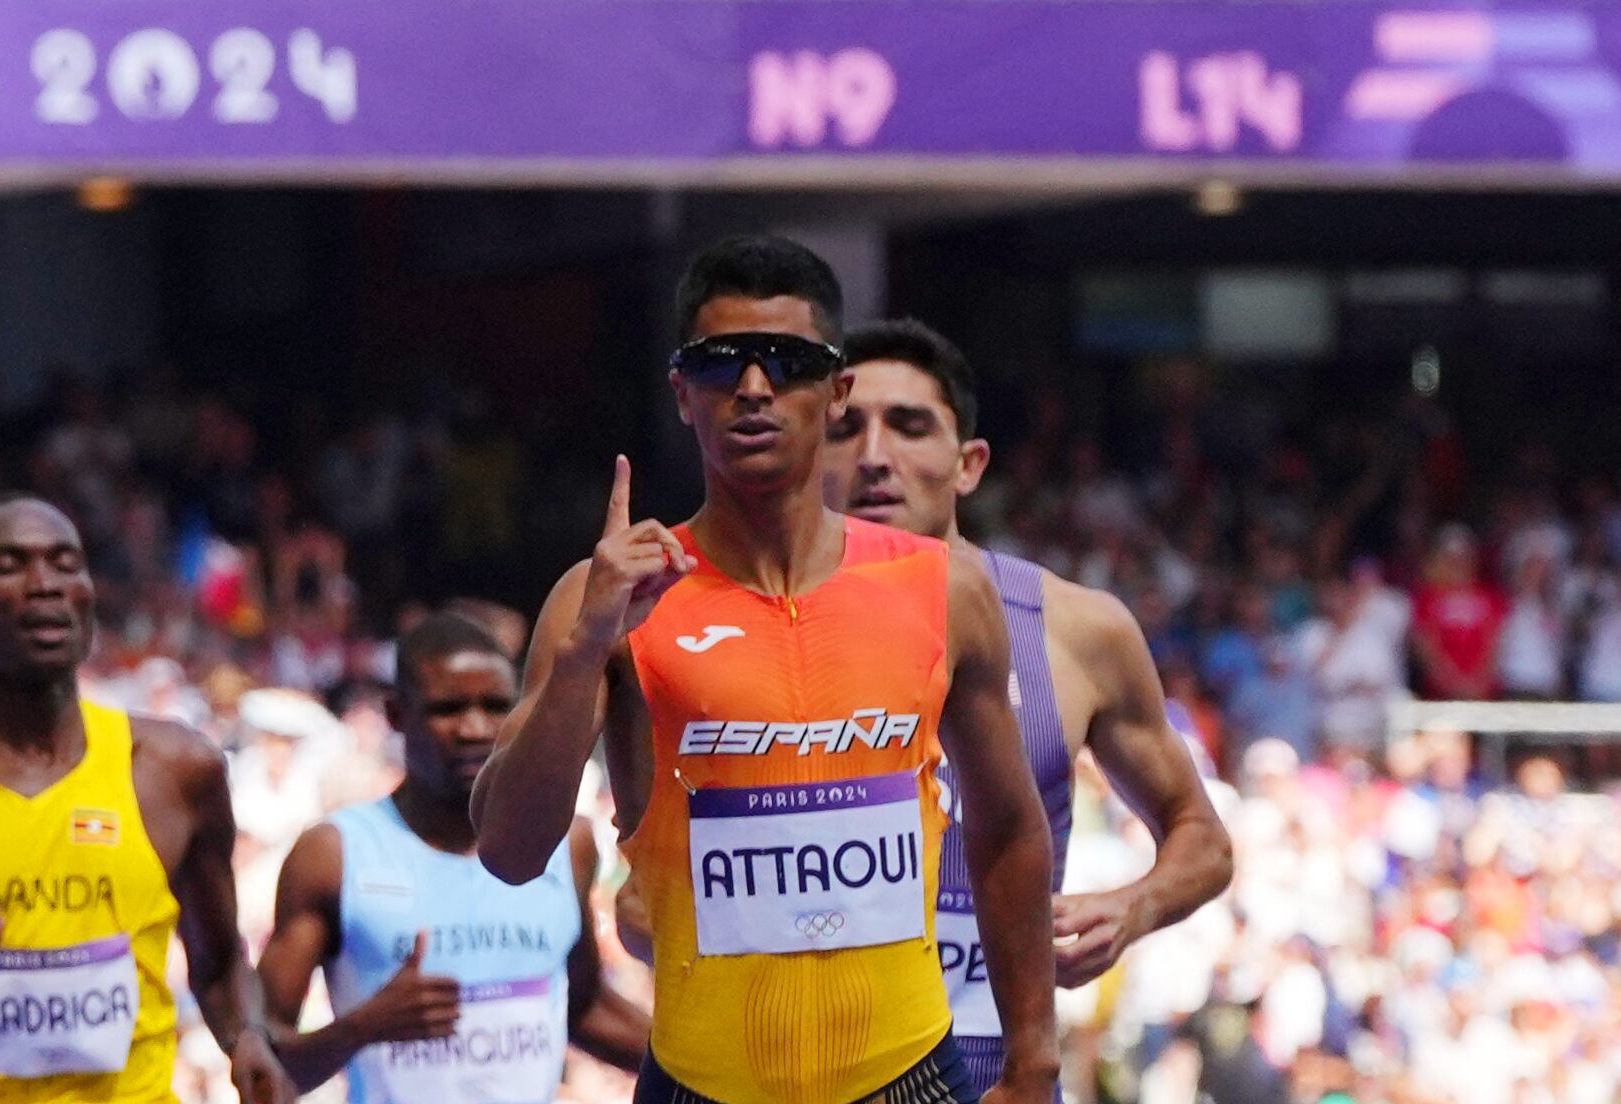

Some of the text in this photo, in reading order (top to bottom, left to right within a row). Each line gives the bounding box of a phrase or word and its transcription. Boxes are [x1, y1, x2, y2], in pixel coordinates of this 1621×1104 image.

[28, 26, 359, 126] 2024
[678, 708, 921, 756] ESPAÑA
[748, 785, 868, 810] PARIS 2024
[702, 831, 918, 899] ATTAOUI
[392, 922, 553, 962] BTSWANA
